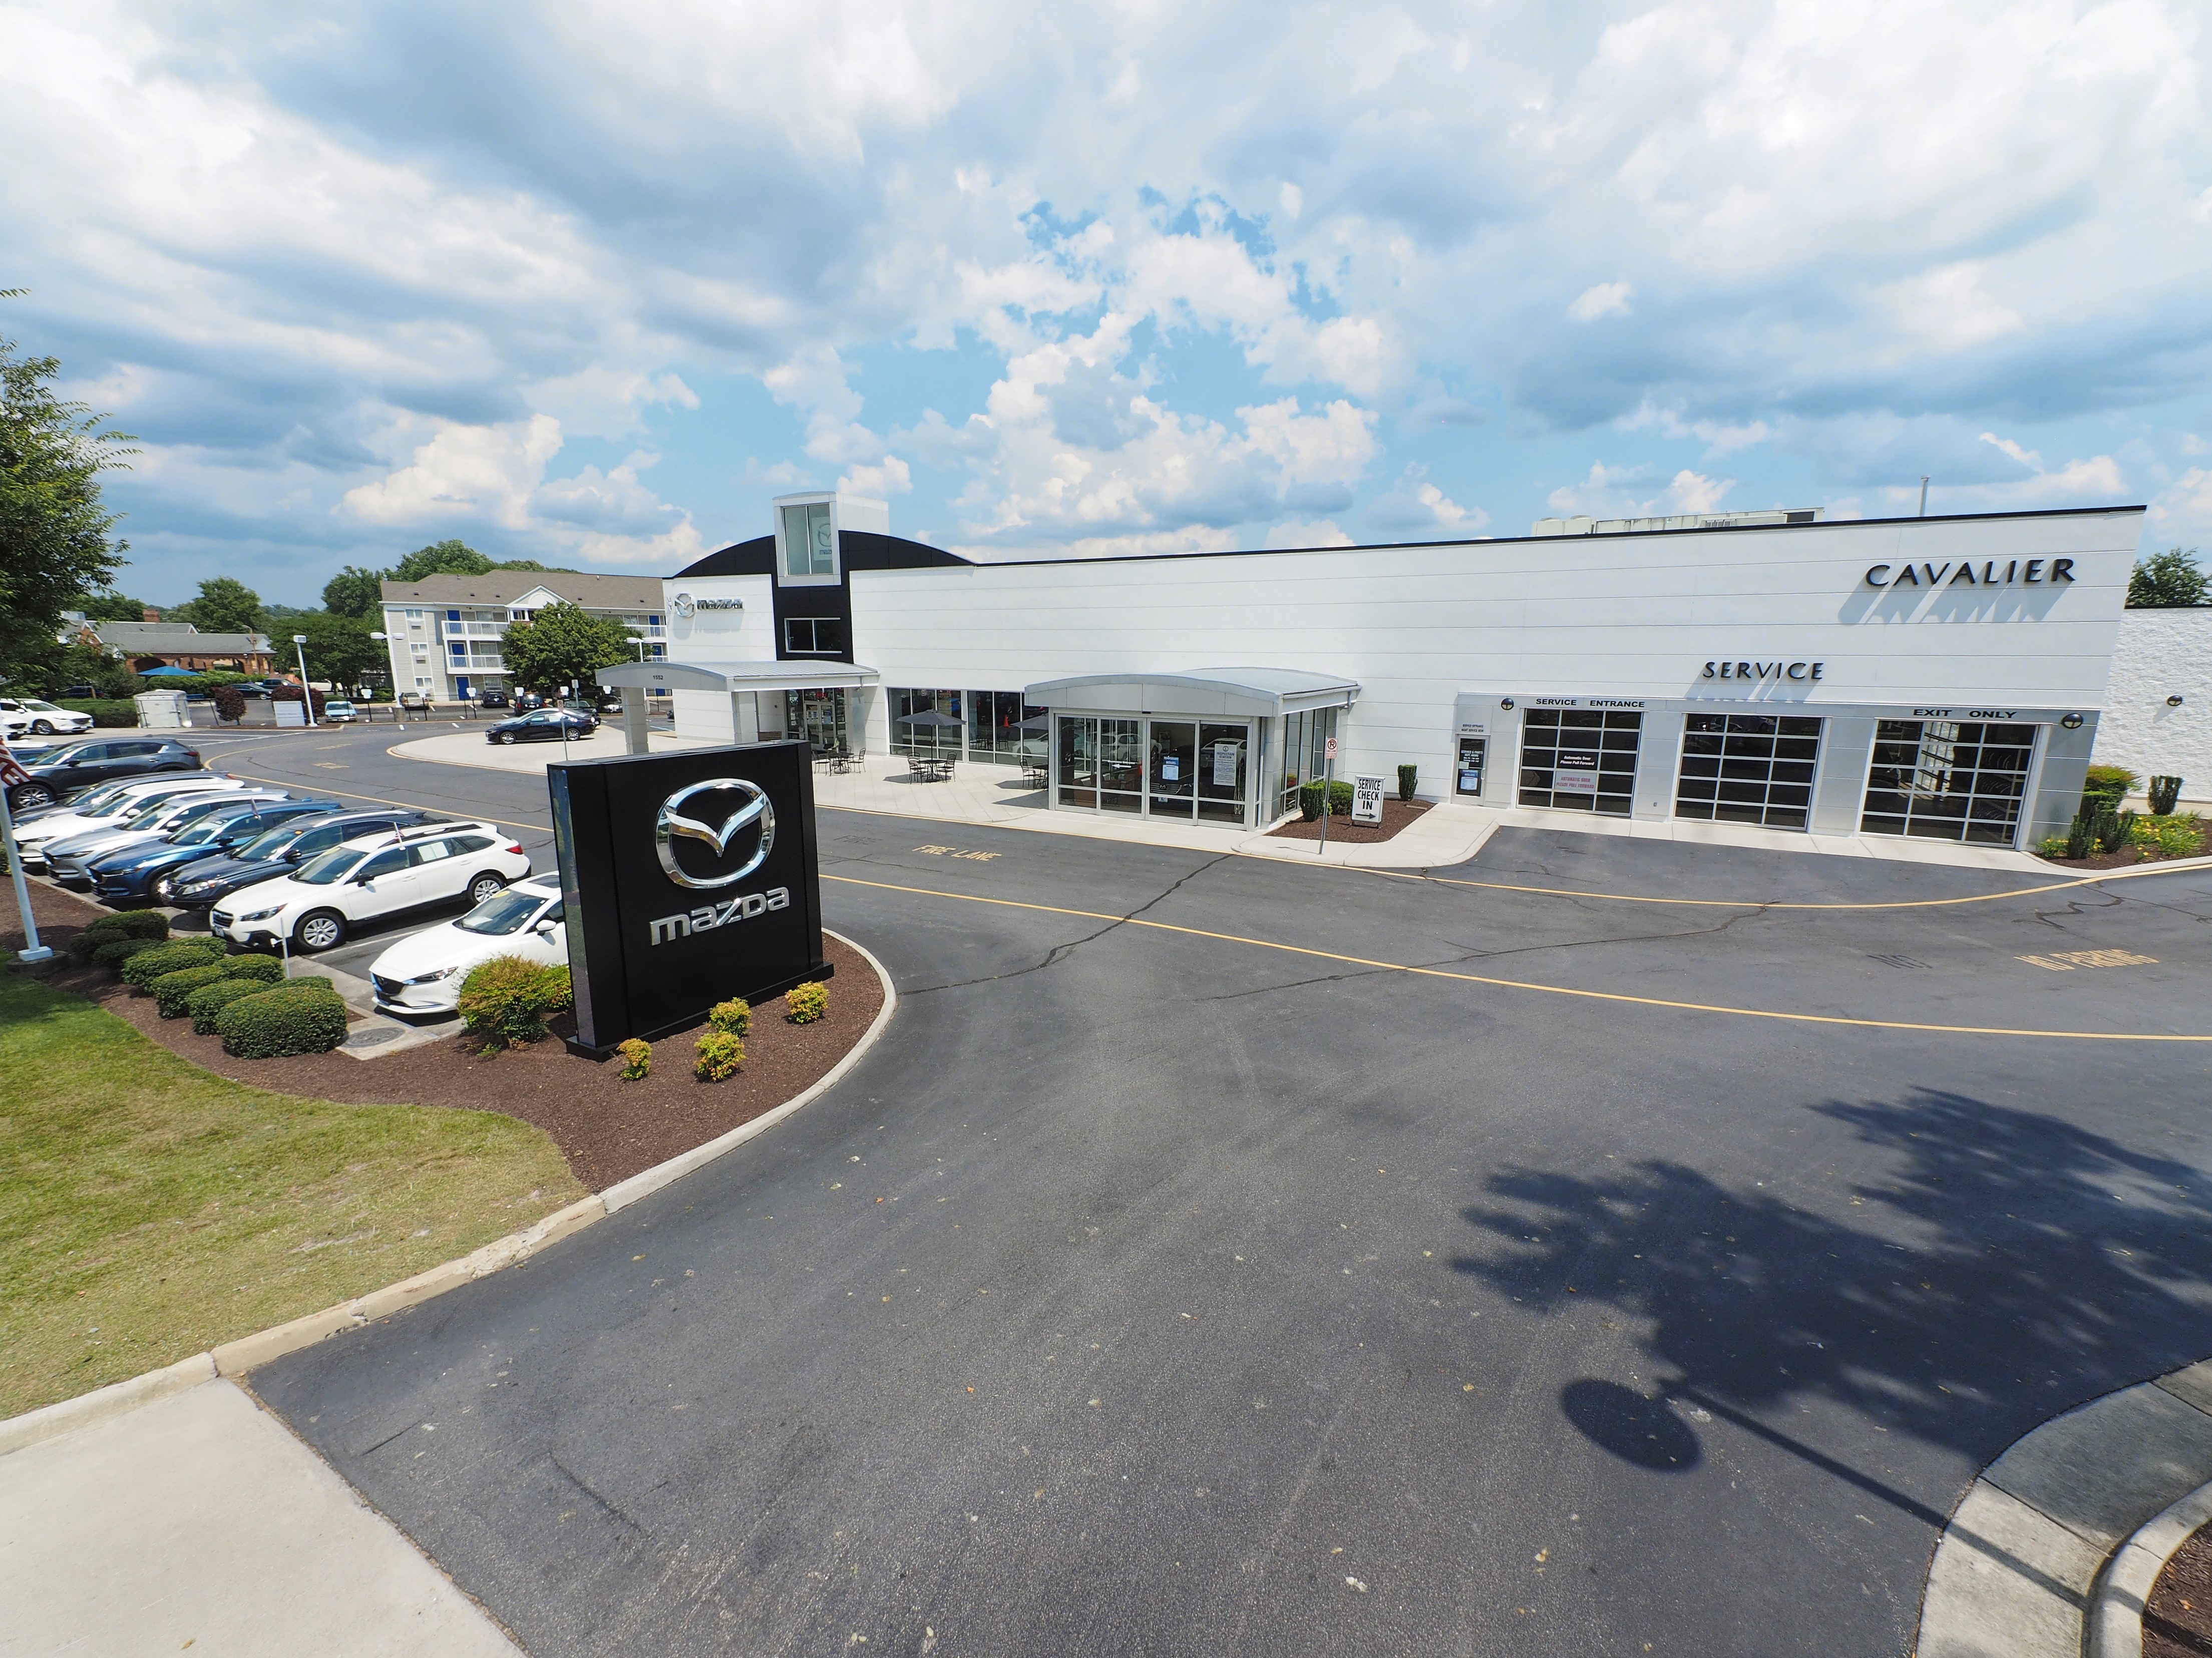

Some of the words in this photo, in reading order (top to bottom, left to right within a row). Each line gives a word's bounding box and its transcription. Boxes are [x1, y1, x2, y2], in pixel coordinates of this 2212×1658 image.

[1866, 558, 2076, 586] CAVALIER
[1702, 662, 1824, 679] SERVICE
[1969, 710, 2017, 718] ONLY
[1358, 778, 1381, 790] SERVICE
[1357, 790, 1379, 801] CHECK
[1362, 800, 1373, 810] IN
[912, 845, 956, 855] FIRE
[951, 850, 1002, 862] LANE
[649, 886, 790, 946] mazda
